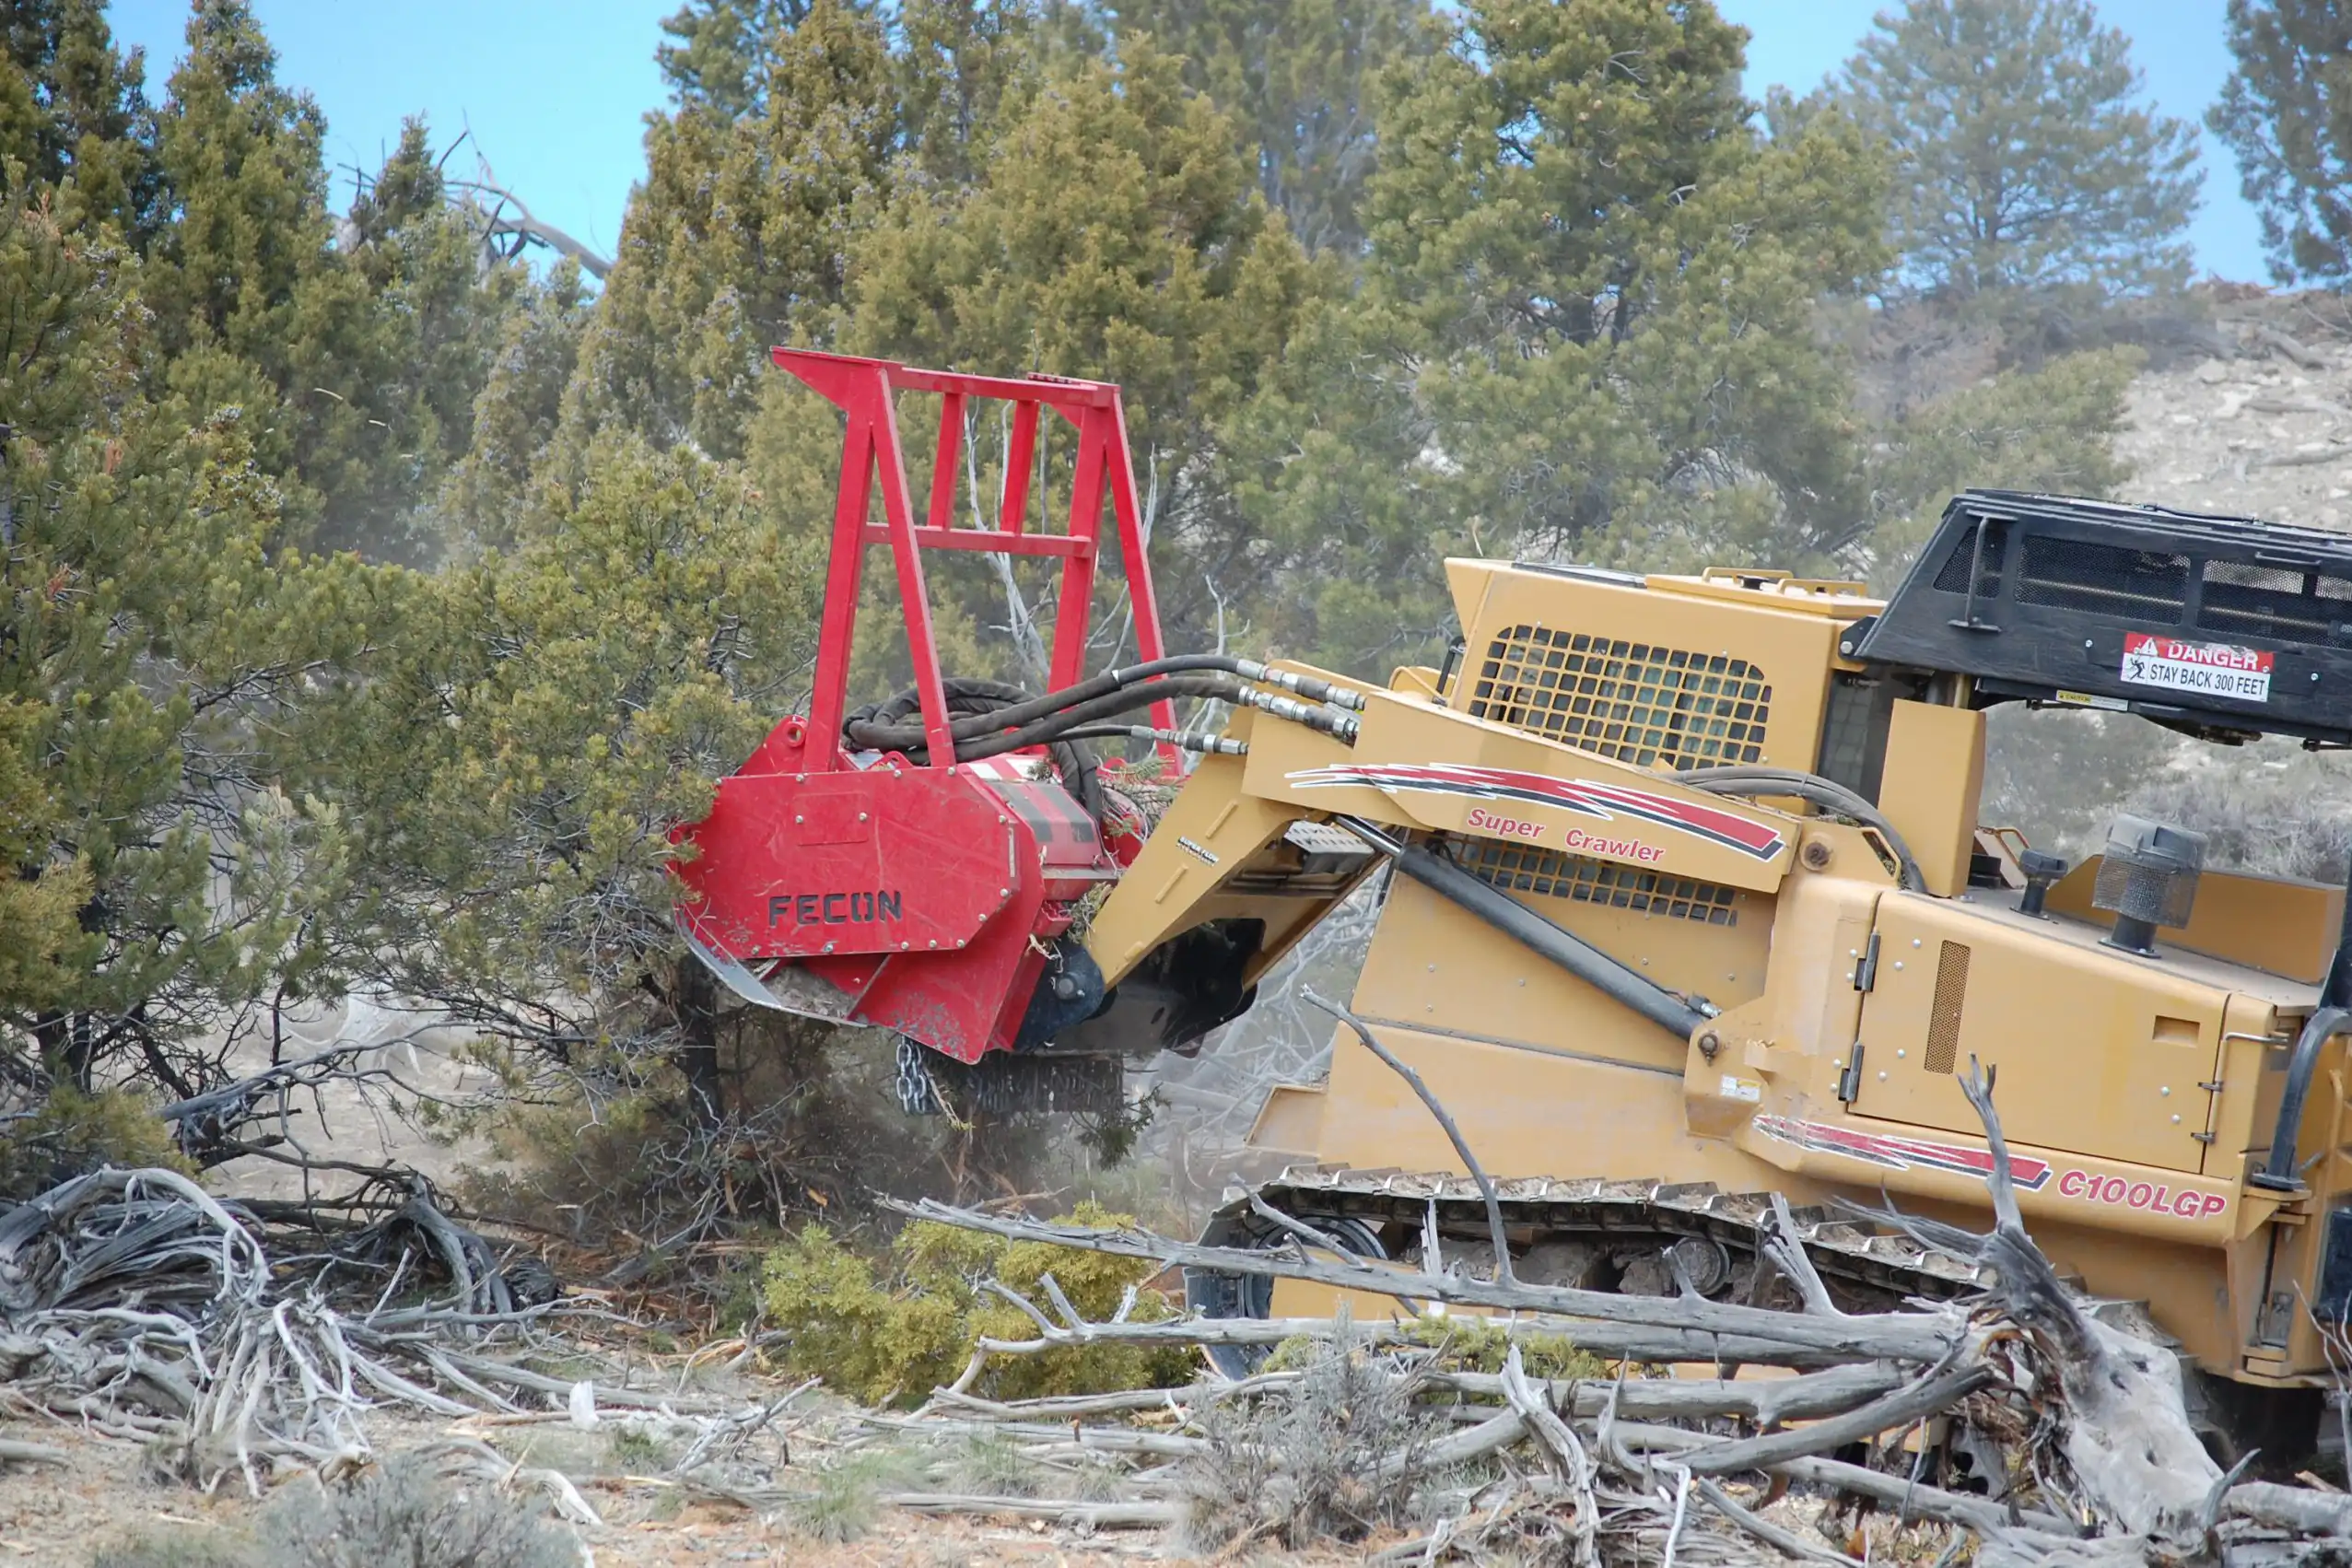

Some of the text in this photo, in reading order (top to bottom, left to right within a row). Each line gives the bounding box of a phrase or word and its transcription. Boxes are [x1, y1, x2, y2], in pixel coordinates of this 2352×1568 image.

[2167, 642, 2258, 671] DANGER
[2149, 663, 2265, 696] STAY BACK 300 FEET
[1468, 808, 1666, 862] Super Crawler
[768, 890, 902, 927] FECON
[2059, 1170, 2226, 1219] C100LGP
